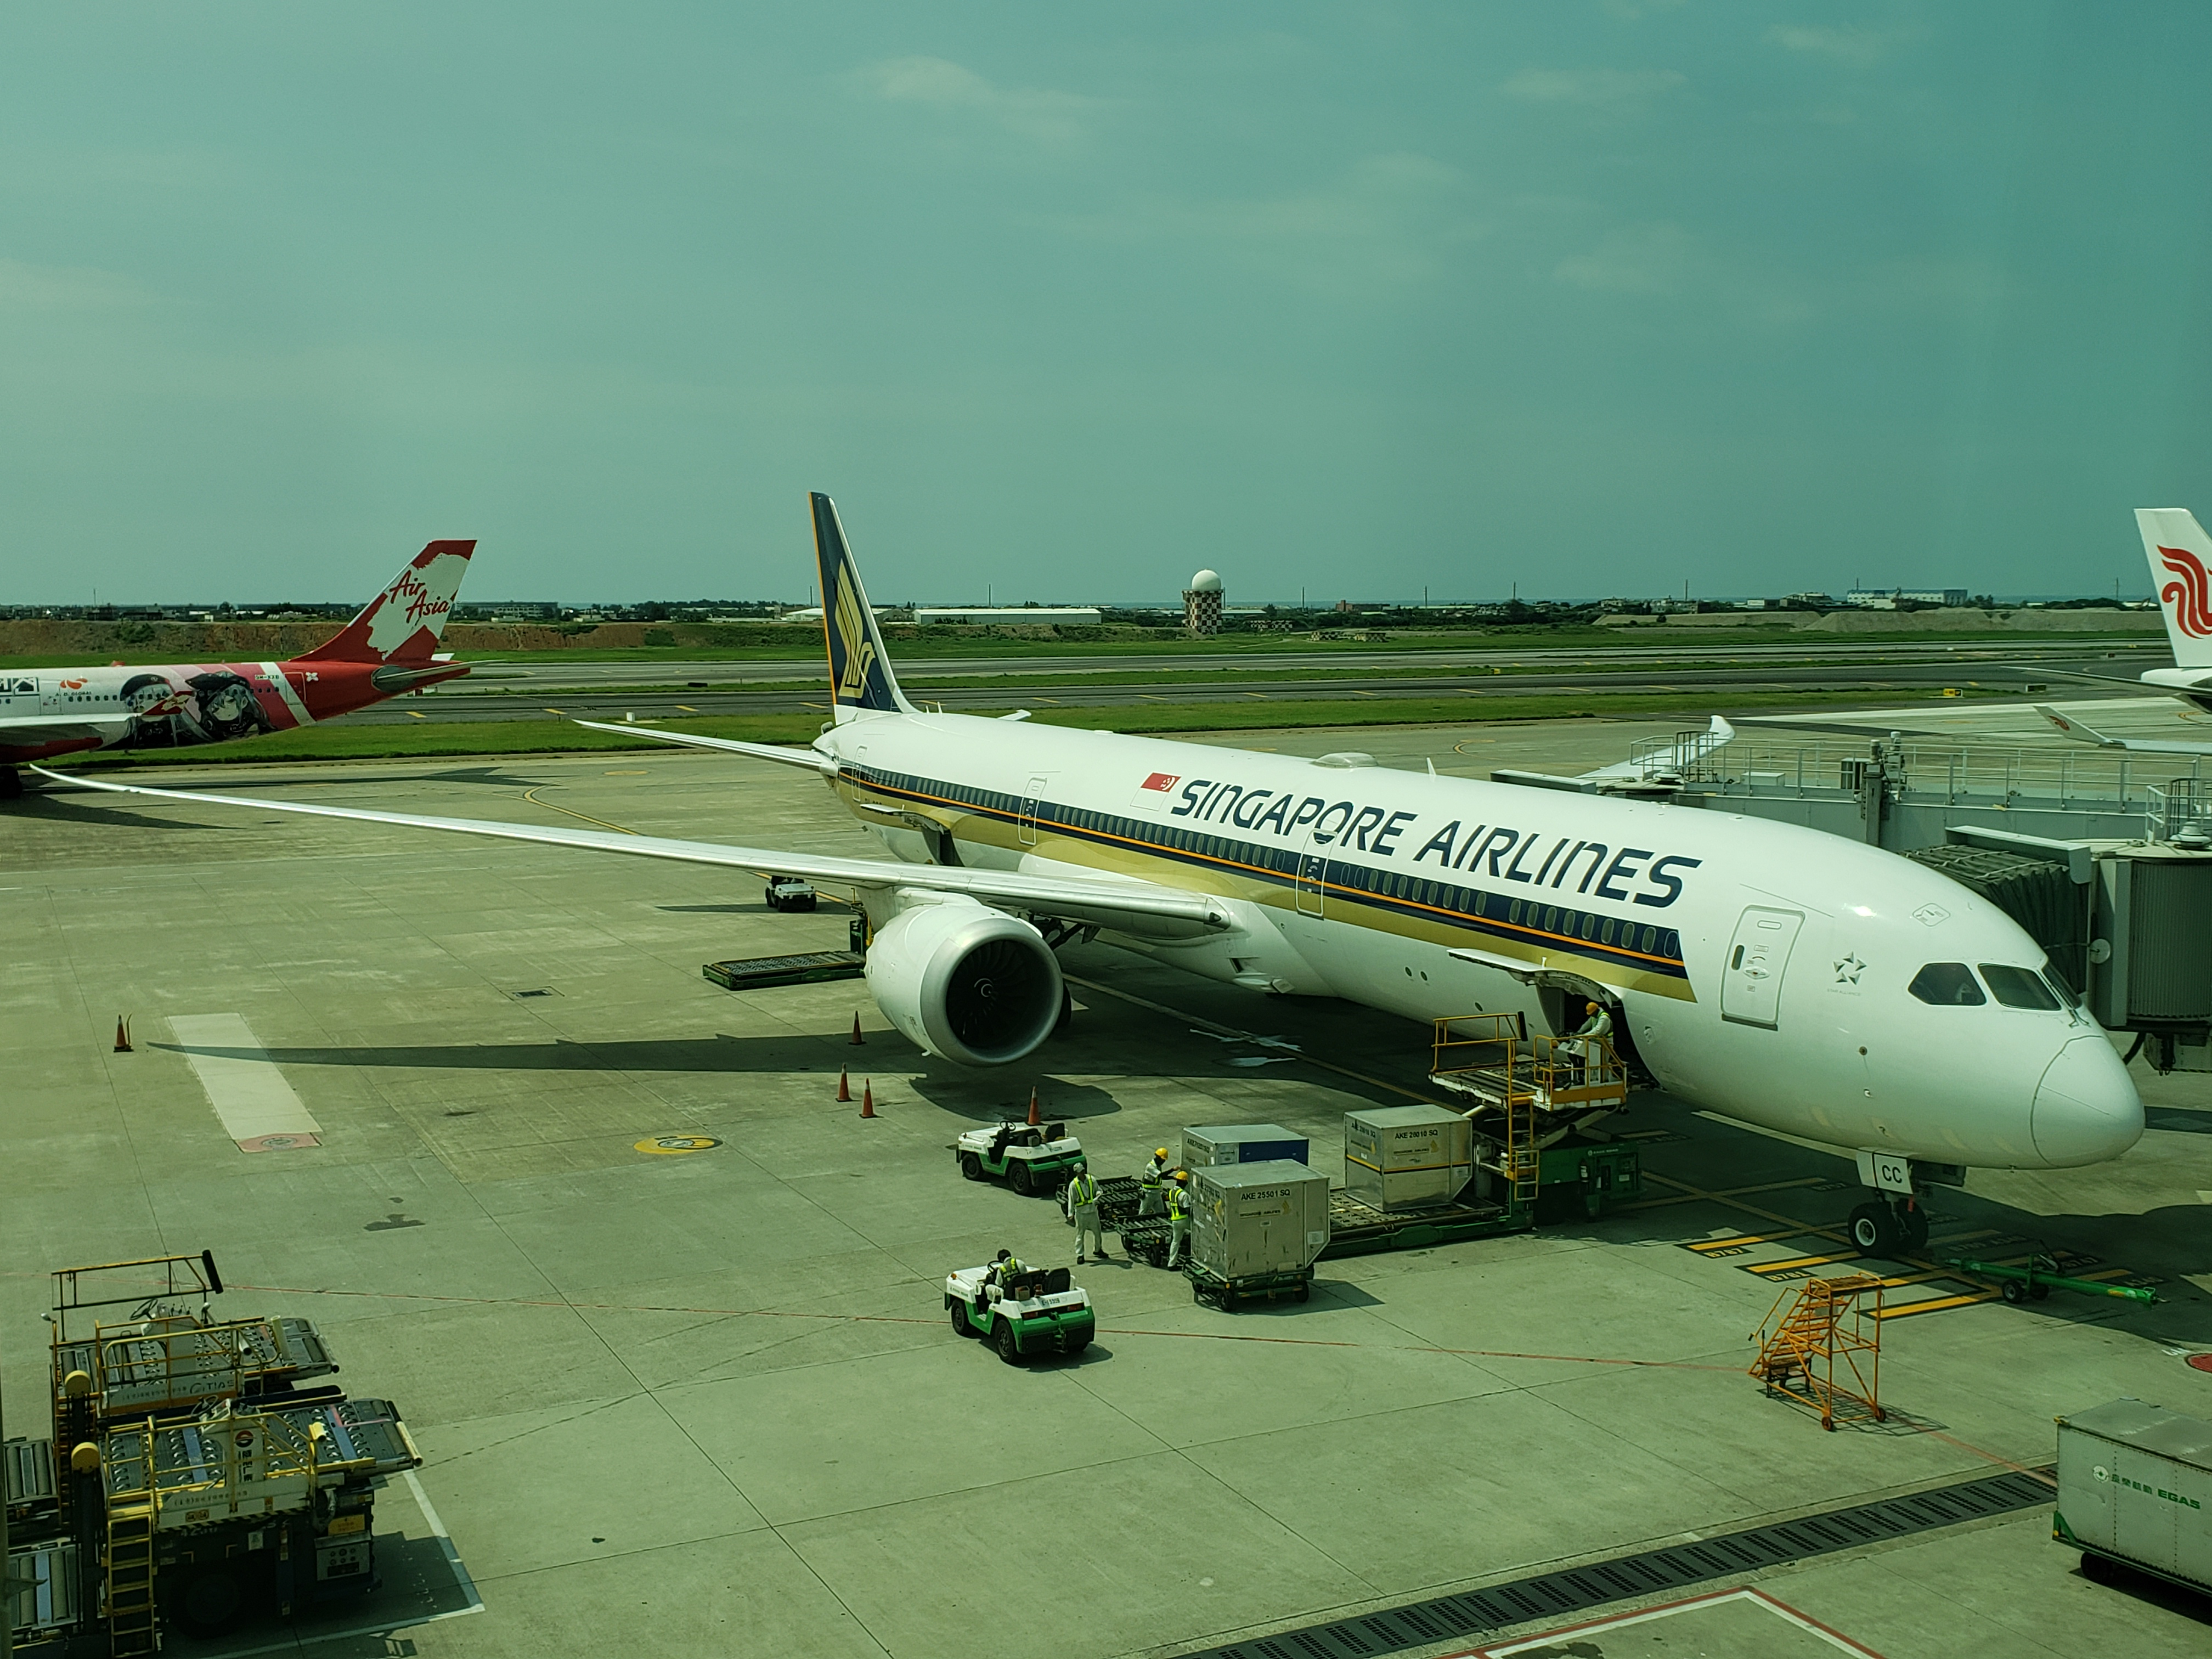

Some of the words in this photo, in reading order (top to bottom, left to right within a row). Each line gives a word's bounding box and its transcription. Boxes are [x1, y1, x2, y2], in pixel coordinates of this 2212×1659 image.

[389, 569, 426, 604] Air
[405, 589, 450, 623] Asia
[1171, 780, 1419, 856] SINGAPORE
[1413, 821, 1703, 908] AIRLINES
[1882, 1165, 1902, 1183] CC
[1241, 1192, 1256, 1200] AKE
[2157, 1488, 2199, 1509] EGAS
